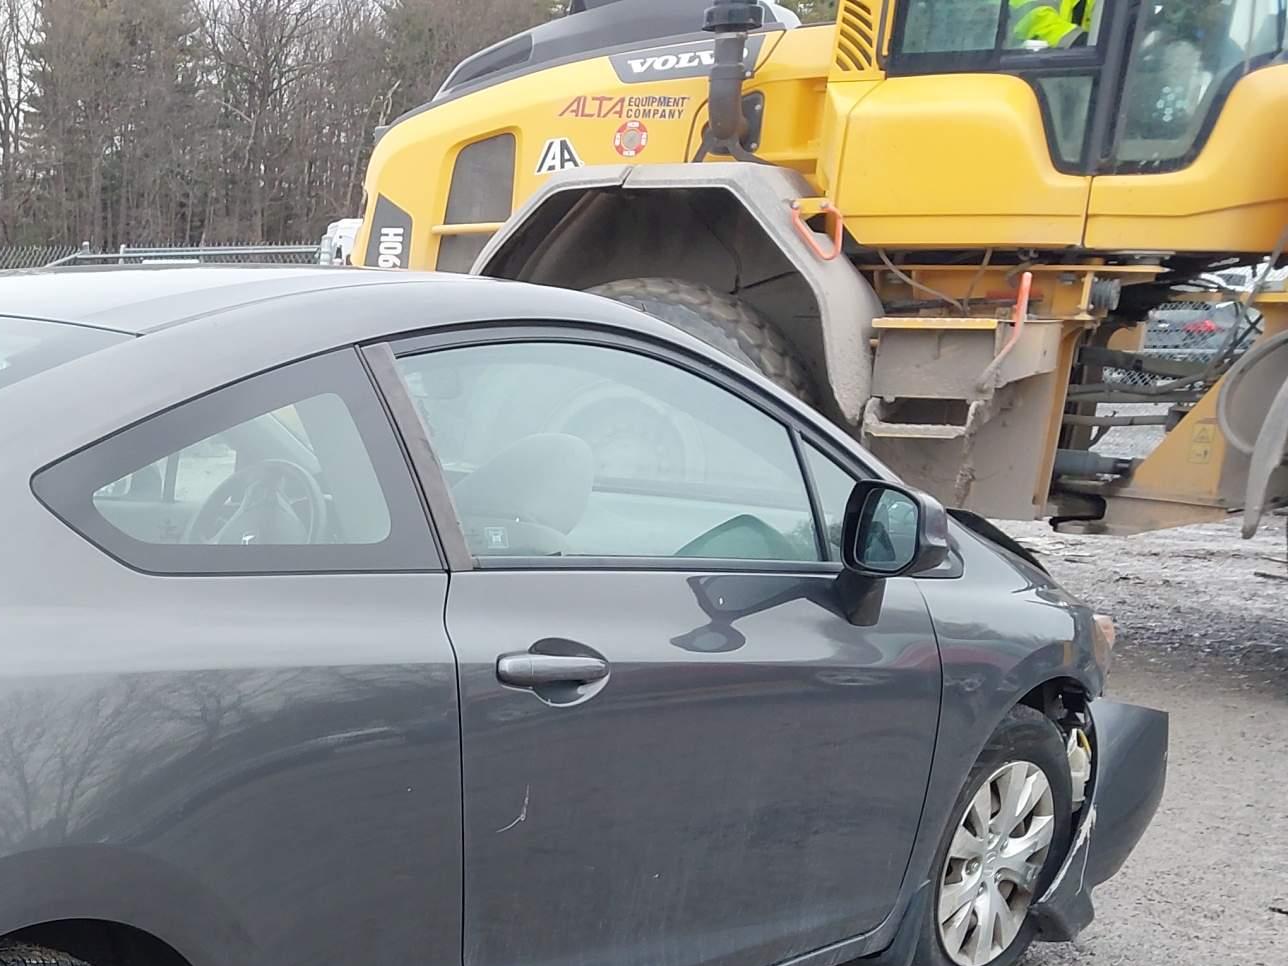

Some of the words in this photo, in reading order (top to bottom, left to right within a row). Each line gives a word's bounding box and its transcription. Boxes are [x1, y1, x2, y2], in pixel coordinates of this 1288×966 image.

[627, 47, 748, 73] VOLV
[558, 96, 626, 118] ALTA
[627, 96, 686, 108] EQUIPMENT
[626, 108, 684, 119] COMPANY
